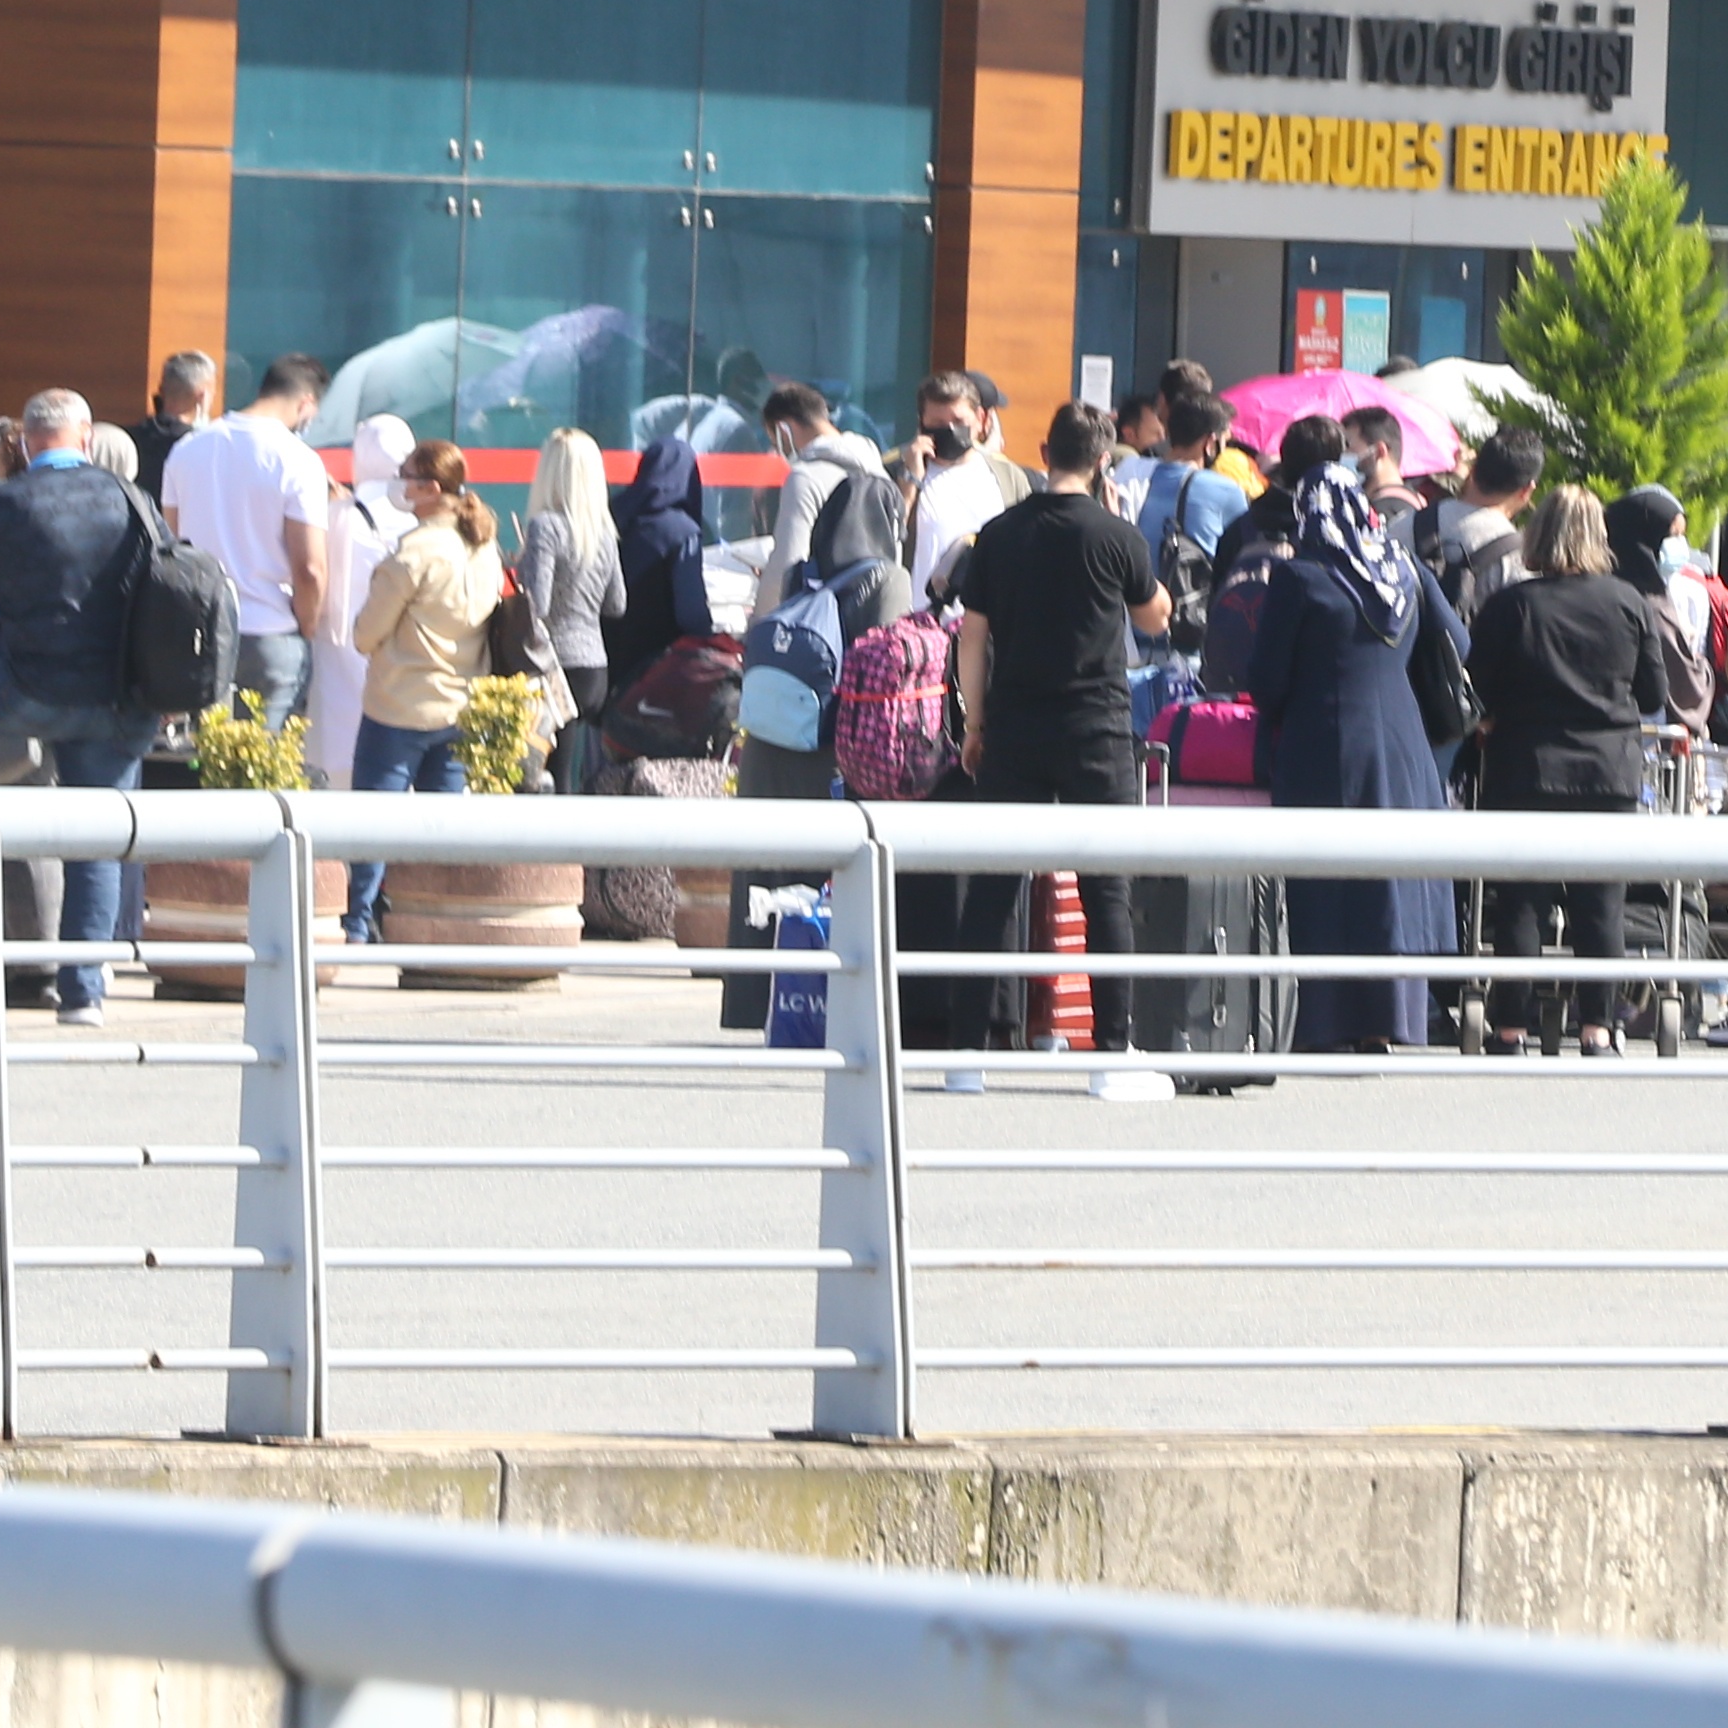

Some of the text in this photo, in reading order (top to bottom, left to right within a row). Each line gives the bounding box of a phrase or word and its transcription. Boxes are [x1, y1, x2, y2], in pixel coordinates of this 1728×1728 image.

[1359, 16, 1501, 90] YOLCU
[1506, 0, 1635, 113] GİRİŞİ
[1168, 109, 1444, 192] DEPARTURES
[778, 992, 804, 1012] LC
